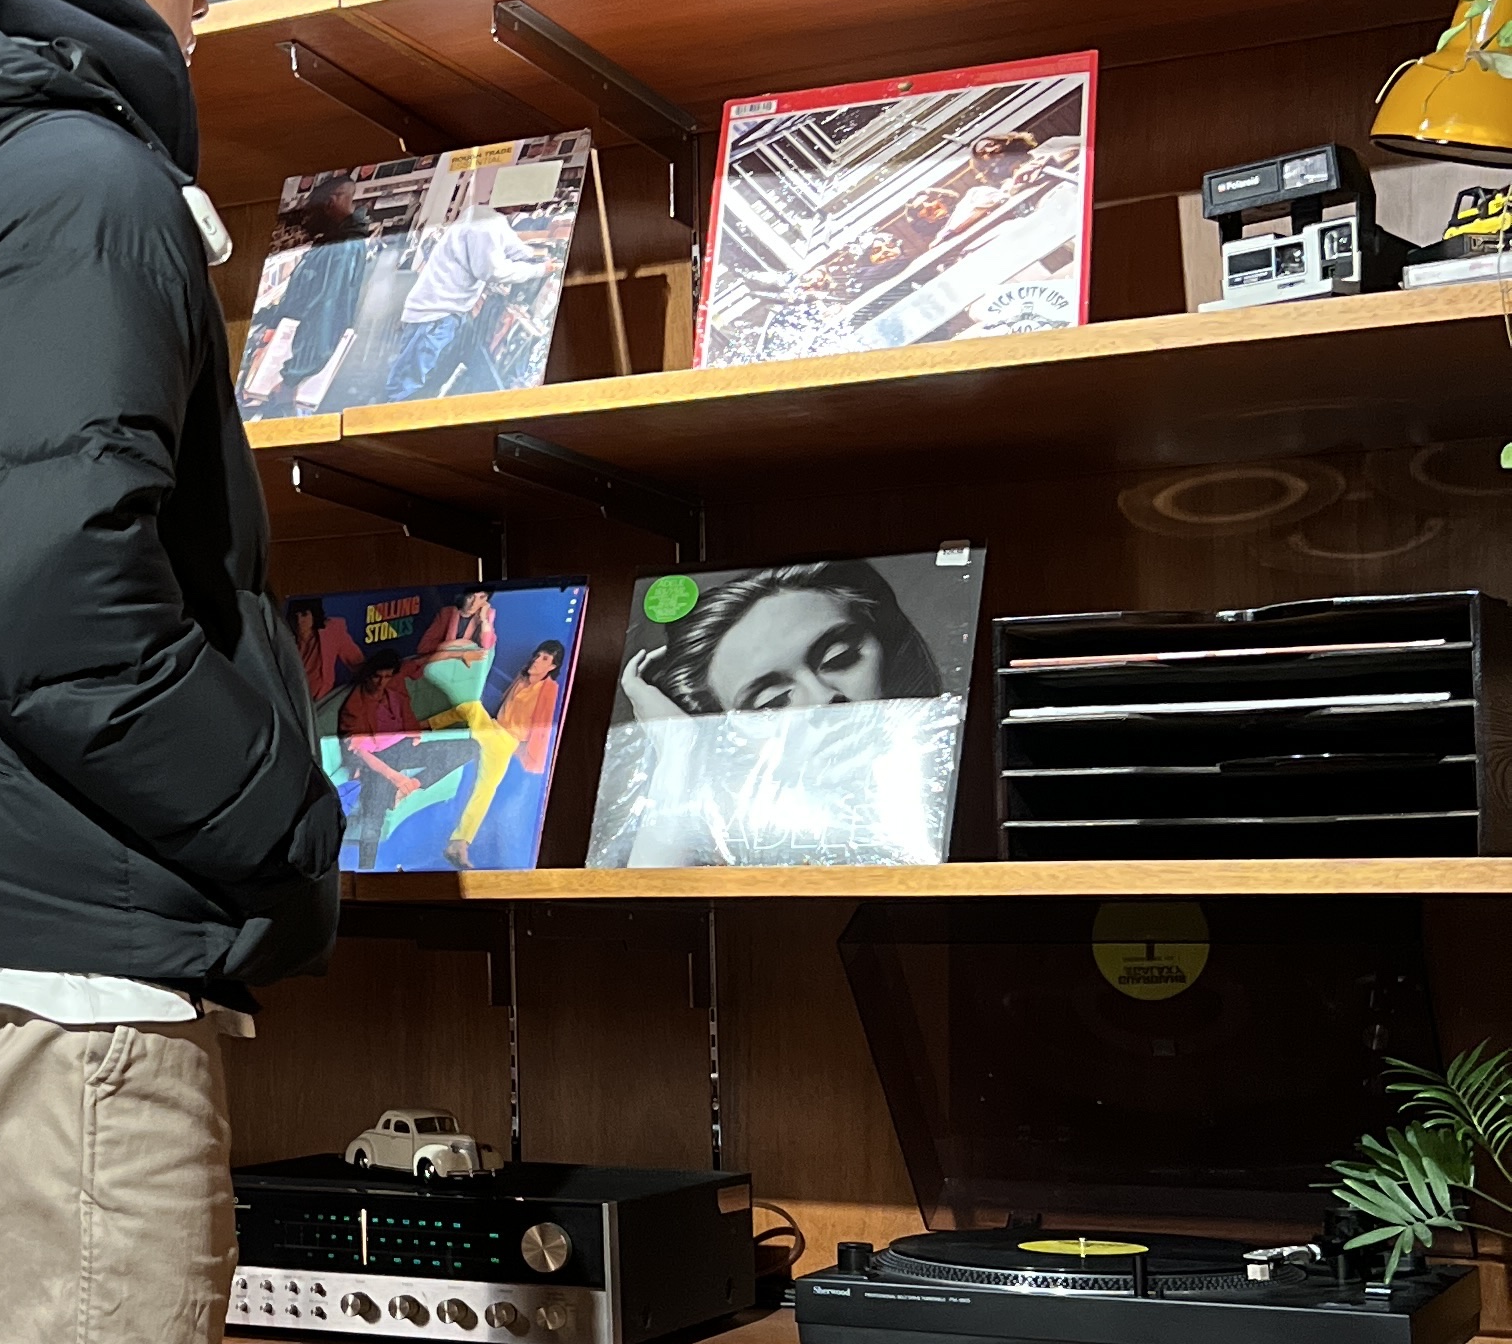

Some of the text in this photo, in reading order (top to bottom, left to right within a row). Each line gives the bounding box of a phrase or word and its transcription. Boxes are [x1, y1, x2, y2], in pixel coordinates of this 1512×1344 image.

[1226, 175, 1260, 191] Polaroid
[987, 286, 1070, 314] SICK CITY USA
[366, 596, 420, 623] ROLLING
[365, 617, 413, 643] STONES
[813, 1285, 851, 1297] Sherwood
